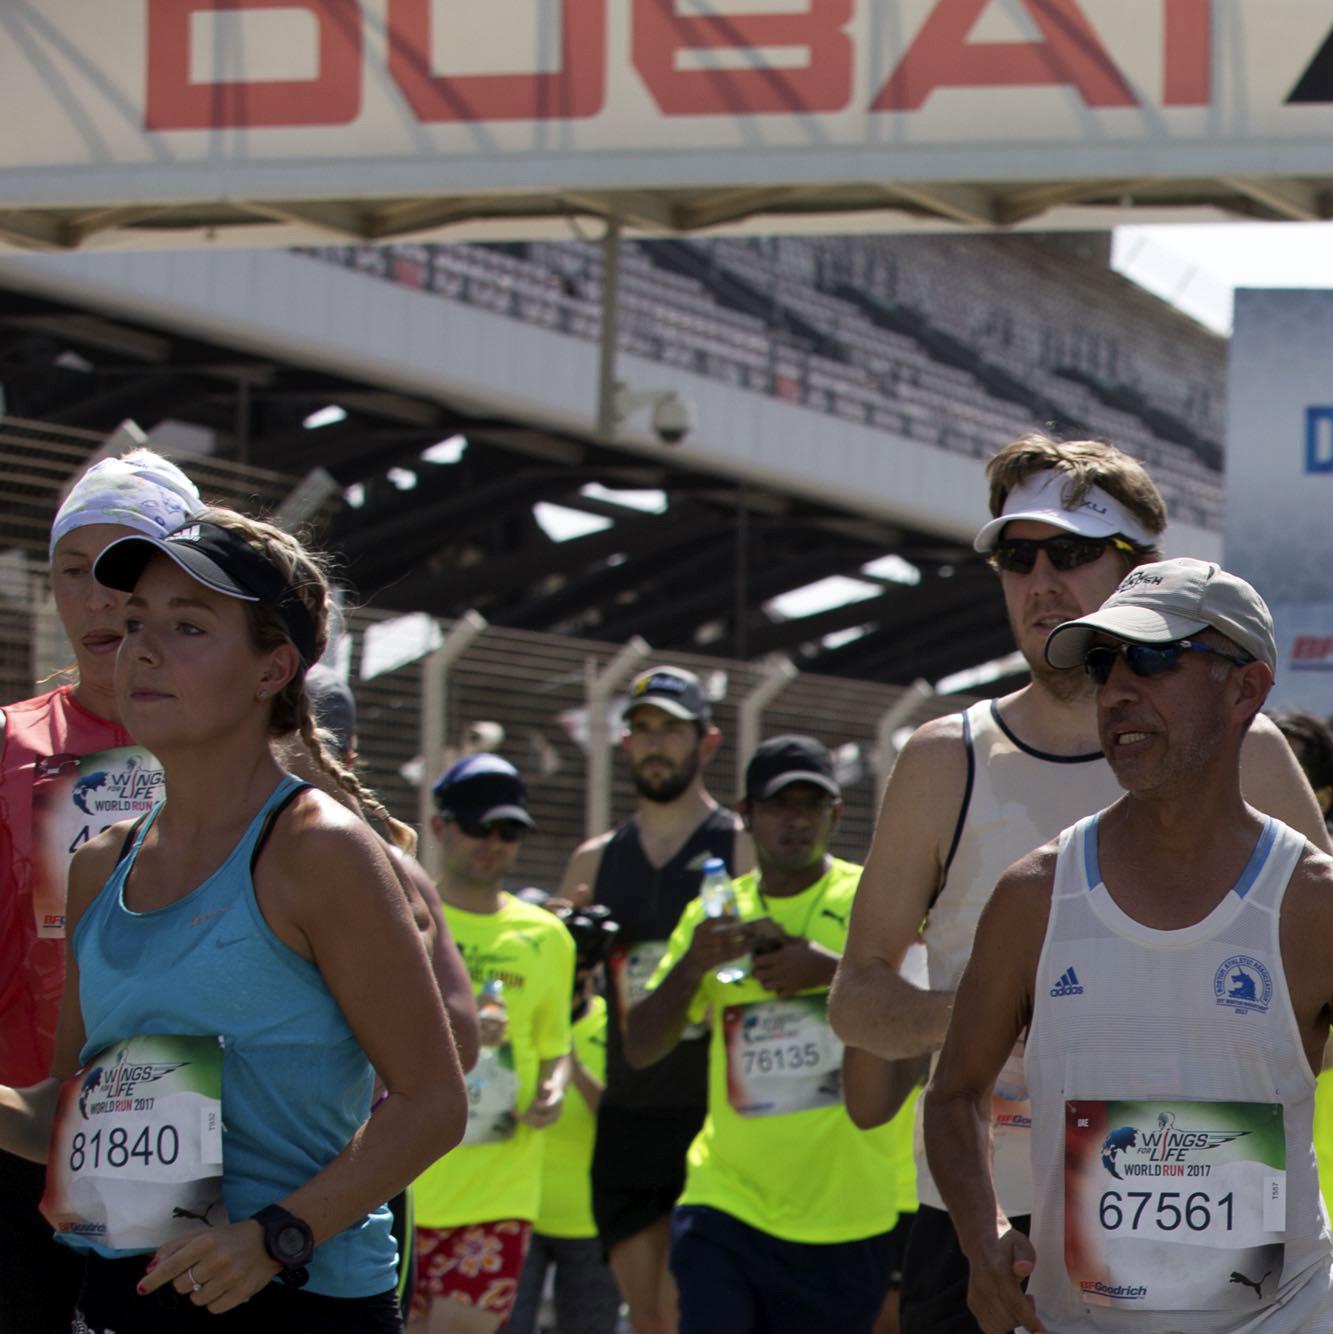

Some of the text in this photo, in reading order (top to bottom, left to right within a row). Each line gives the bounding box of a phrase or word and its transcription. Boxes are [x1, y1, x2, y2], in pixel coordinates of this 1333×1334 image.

[105, 1066, 153, 1083] WINGS
[107, 1082, 137, 1098] LIFE
[115, 1100, 133, 1113] RUN
[134, 1098, 155, 1111] 2017
[69, 1124, 179, 1171] 81840
[1142, 1132, 1209, 1148] WINGS
[1150, 1147, 1190, 1162] LIFE
[1124, 1164, 1211, 1176] WORLD RUN 2017
[1099, 1190, 1234, 1231] 67561
[1080, 1280, 1148, 1296] BFGoodrich
